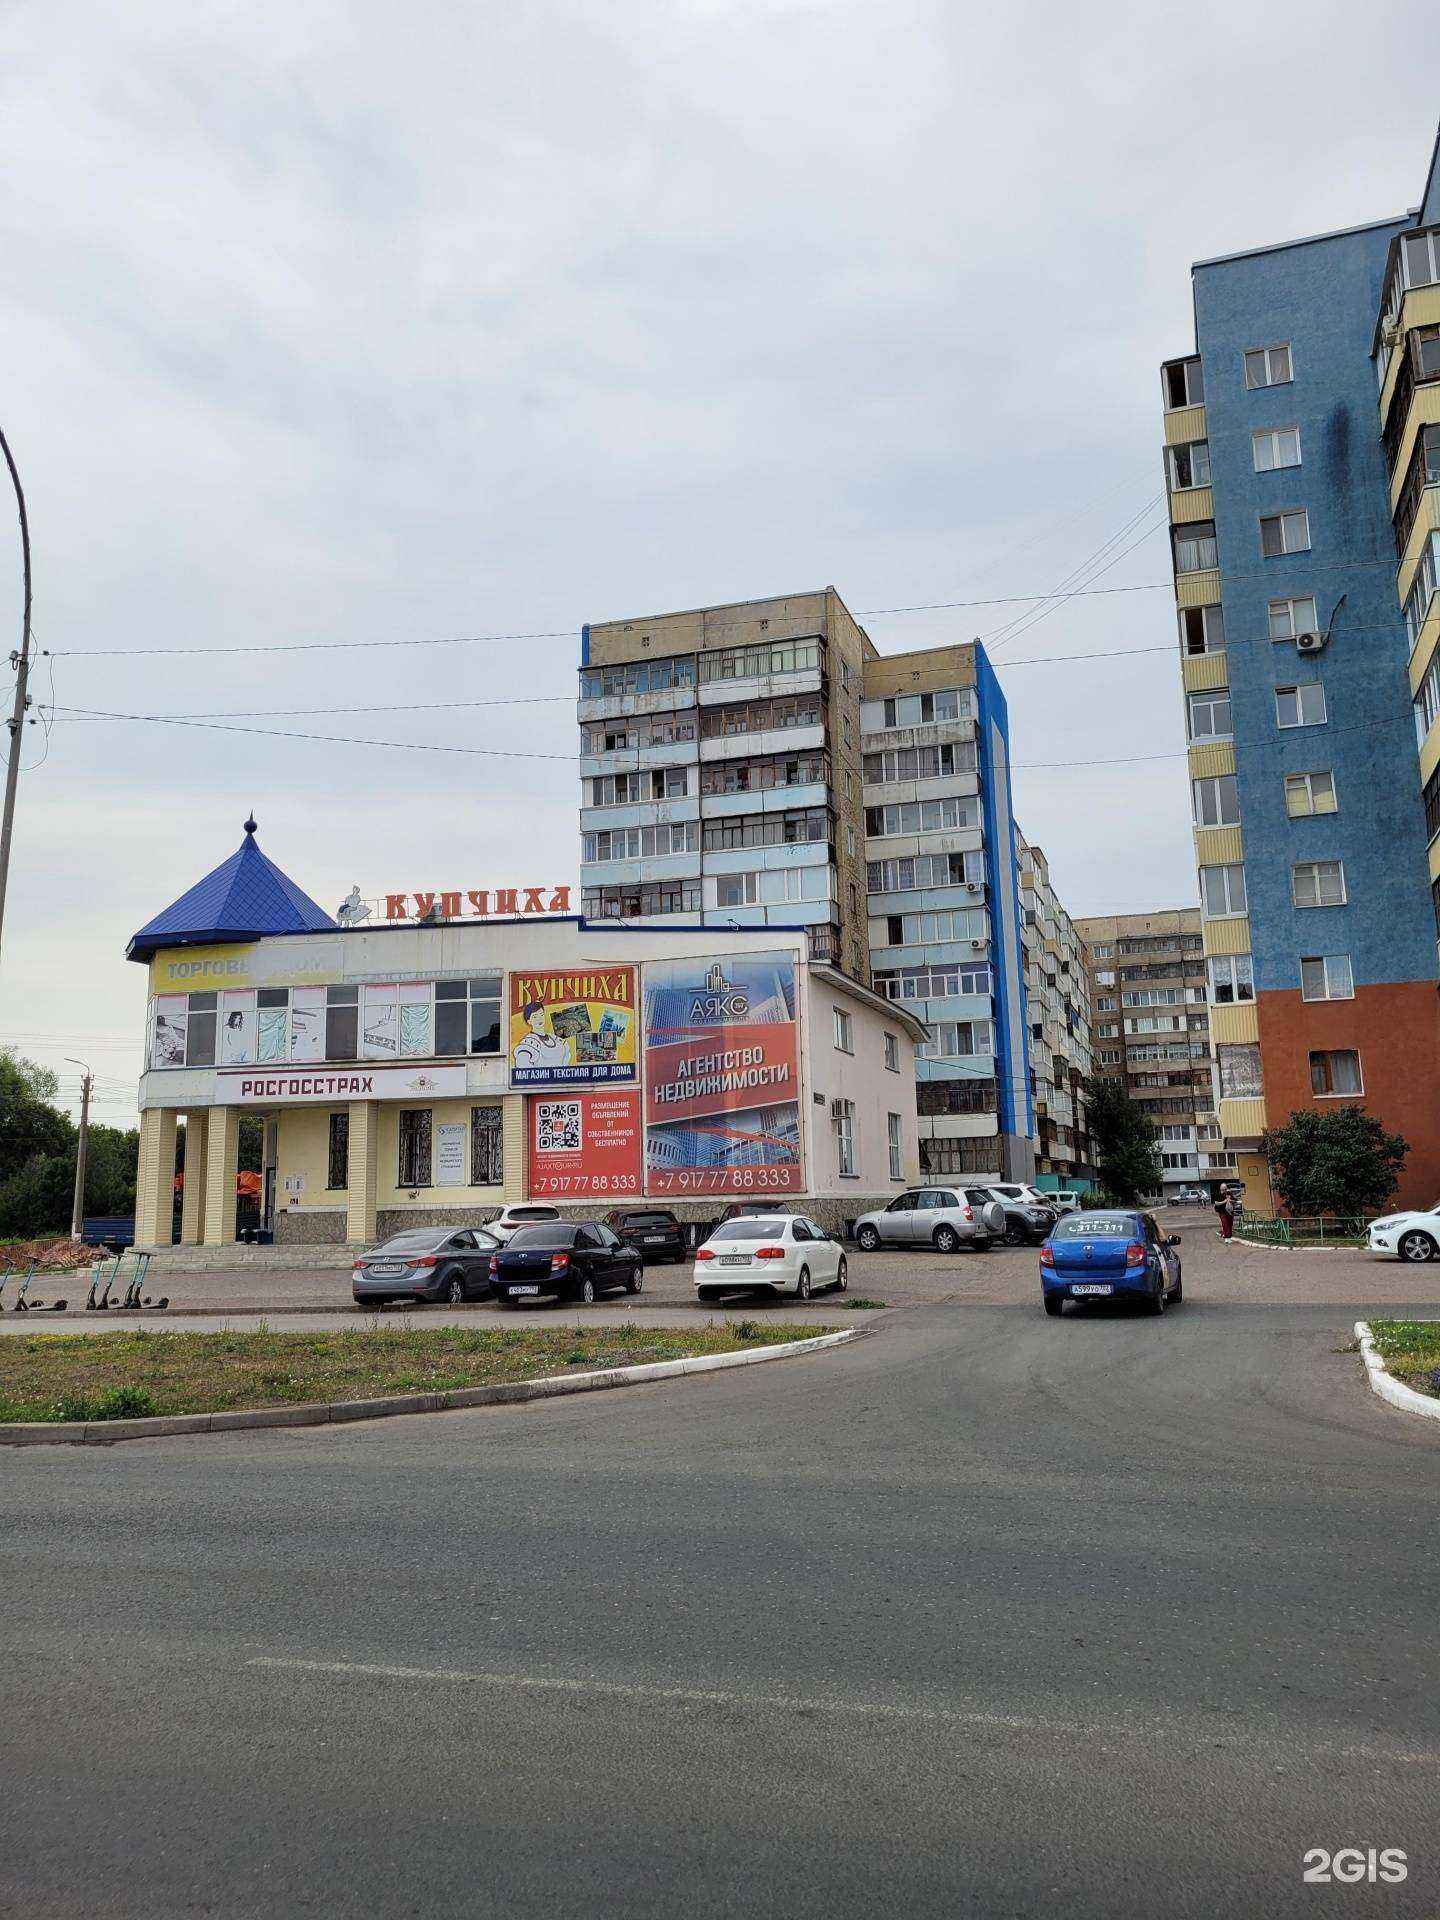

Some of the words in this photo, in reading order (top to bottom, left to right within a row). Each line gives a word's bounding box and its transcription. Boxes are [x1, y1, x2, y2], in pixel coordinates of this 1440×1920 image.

[385, 886, 571, 920] КУПЧИХА
[518, 973, 628, 1007] КУПЧИХА
[690, 995, 748, 1018] АЯКС
[515, 1068, 550, 1080] МАГАЗИН
[553, 1067, 590, 1079] ТЕКСТИЛЯ
[592, 1067, 608, 1079] ДЛЯ
[611, 1065, 632, 1077] ДОМА
[677, 1046, 763, 1078] АГЕНТСТВО
[241, 1076, 373, 1097] РОСГОССТРАХ
[653, 1062, 789, 1104] НЕДВИЖИМОСТИ
[550, 1176, 571, 1191] 917
[573, 1176, 589, 1190] 77
[591, 1175, 608, 1189] 88
[611, 1174, 637, 1189] 333
[678, 1171, 705, 1188] 917
[708, 1170, 729, 1187] 77
[732, 1169, 754, 1187] 88
[757, 1168, 791, 1186] 333
